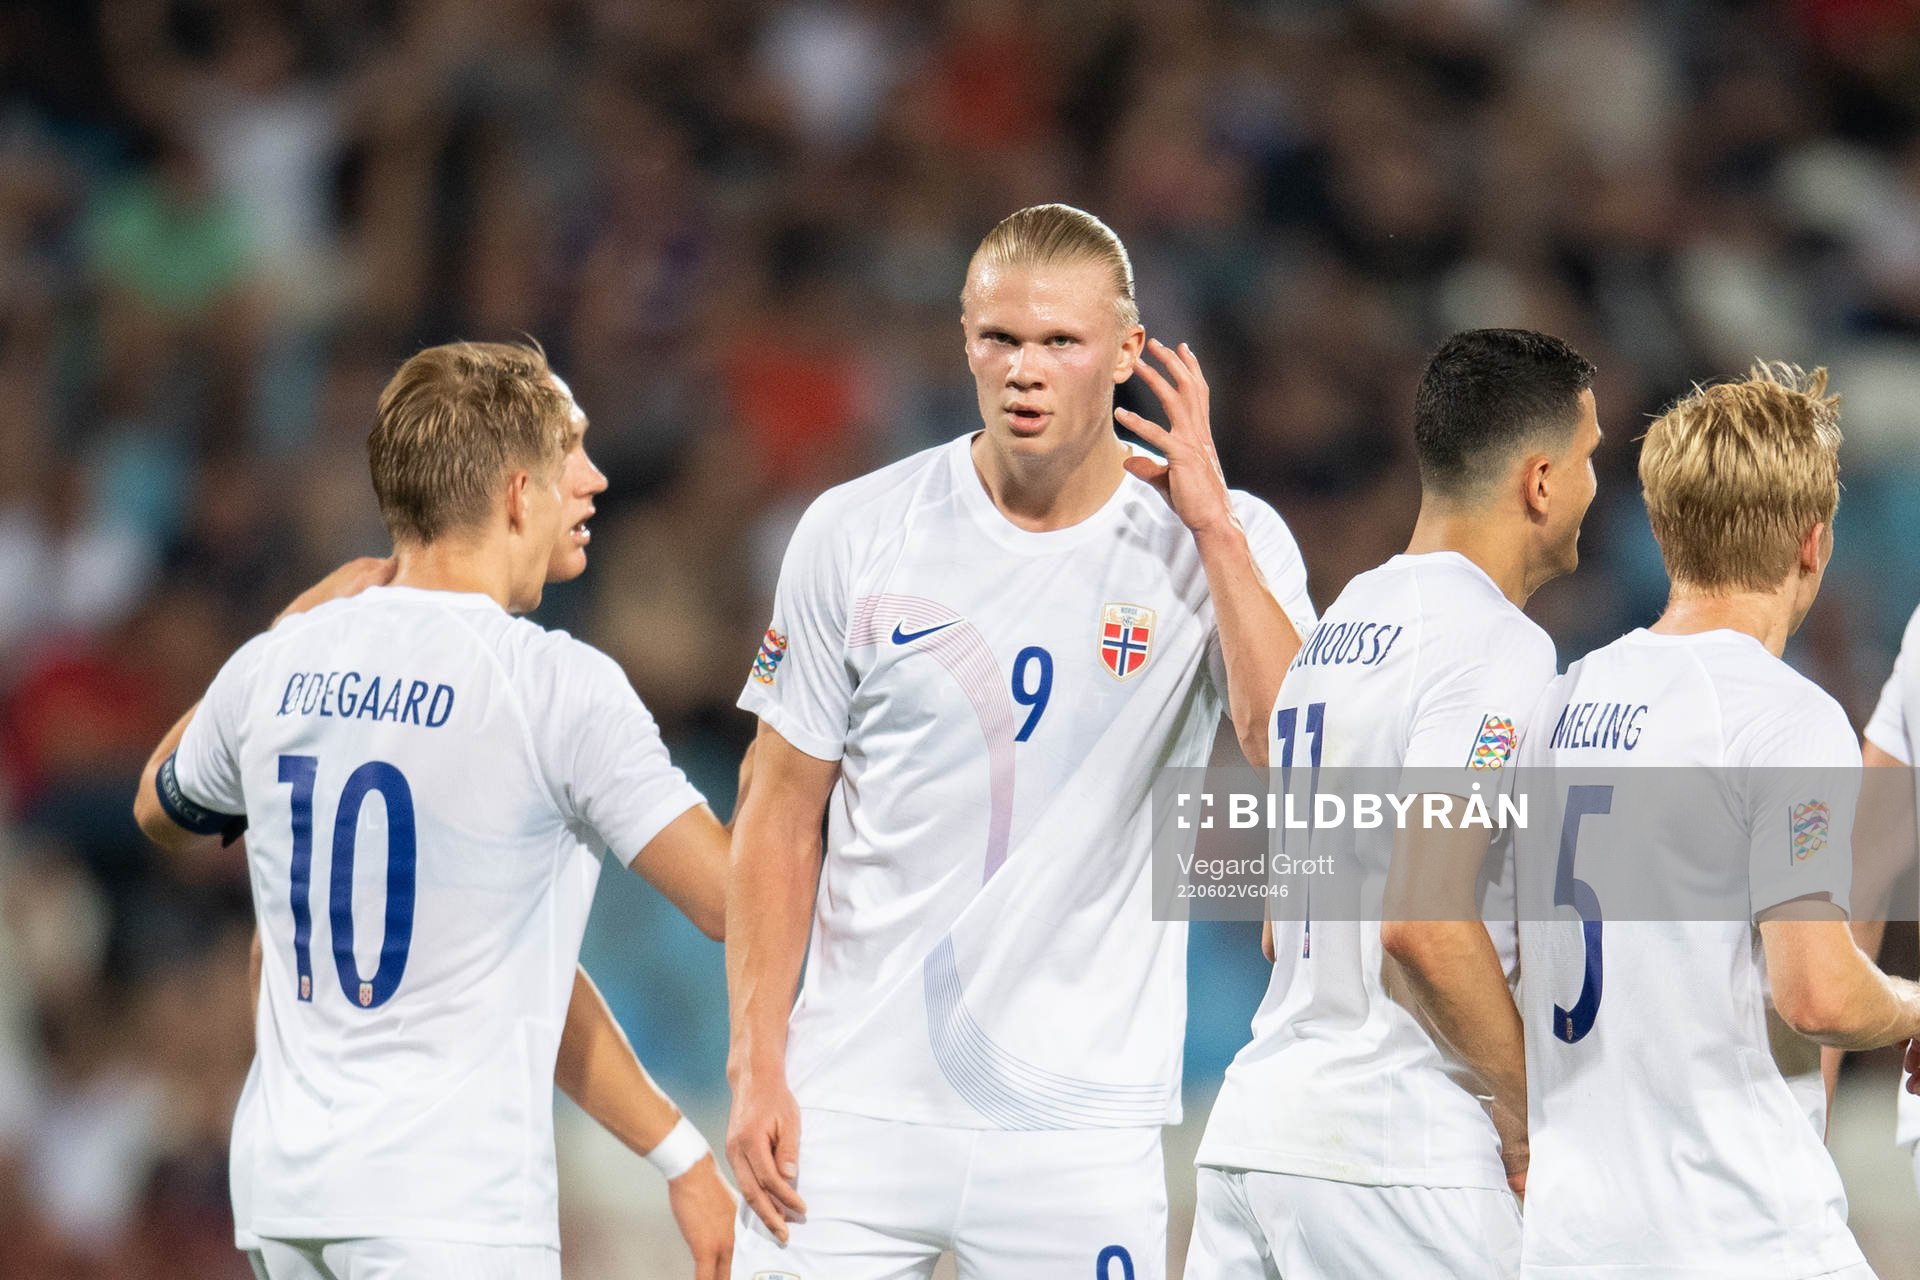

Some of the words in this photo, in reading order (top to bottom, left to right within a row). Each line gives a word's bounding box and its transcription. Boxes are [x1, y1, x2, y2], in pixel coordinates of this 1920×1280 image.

[276, 671, 456, 728] ØDEGAARD
[1011, 645, 1054, 742] 9
[1549, 702, 1648, 751] MELING
[278, 754, 417, 1009] 10
[1277, 702, 1327, 959] 11
[1553, 785, 1614, 1044] 5
